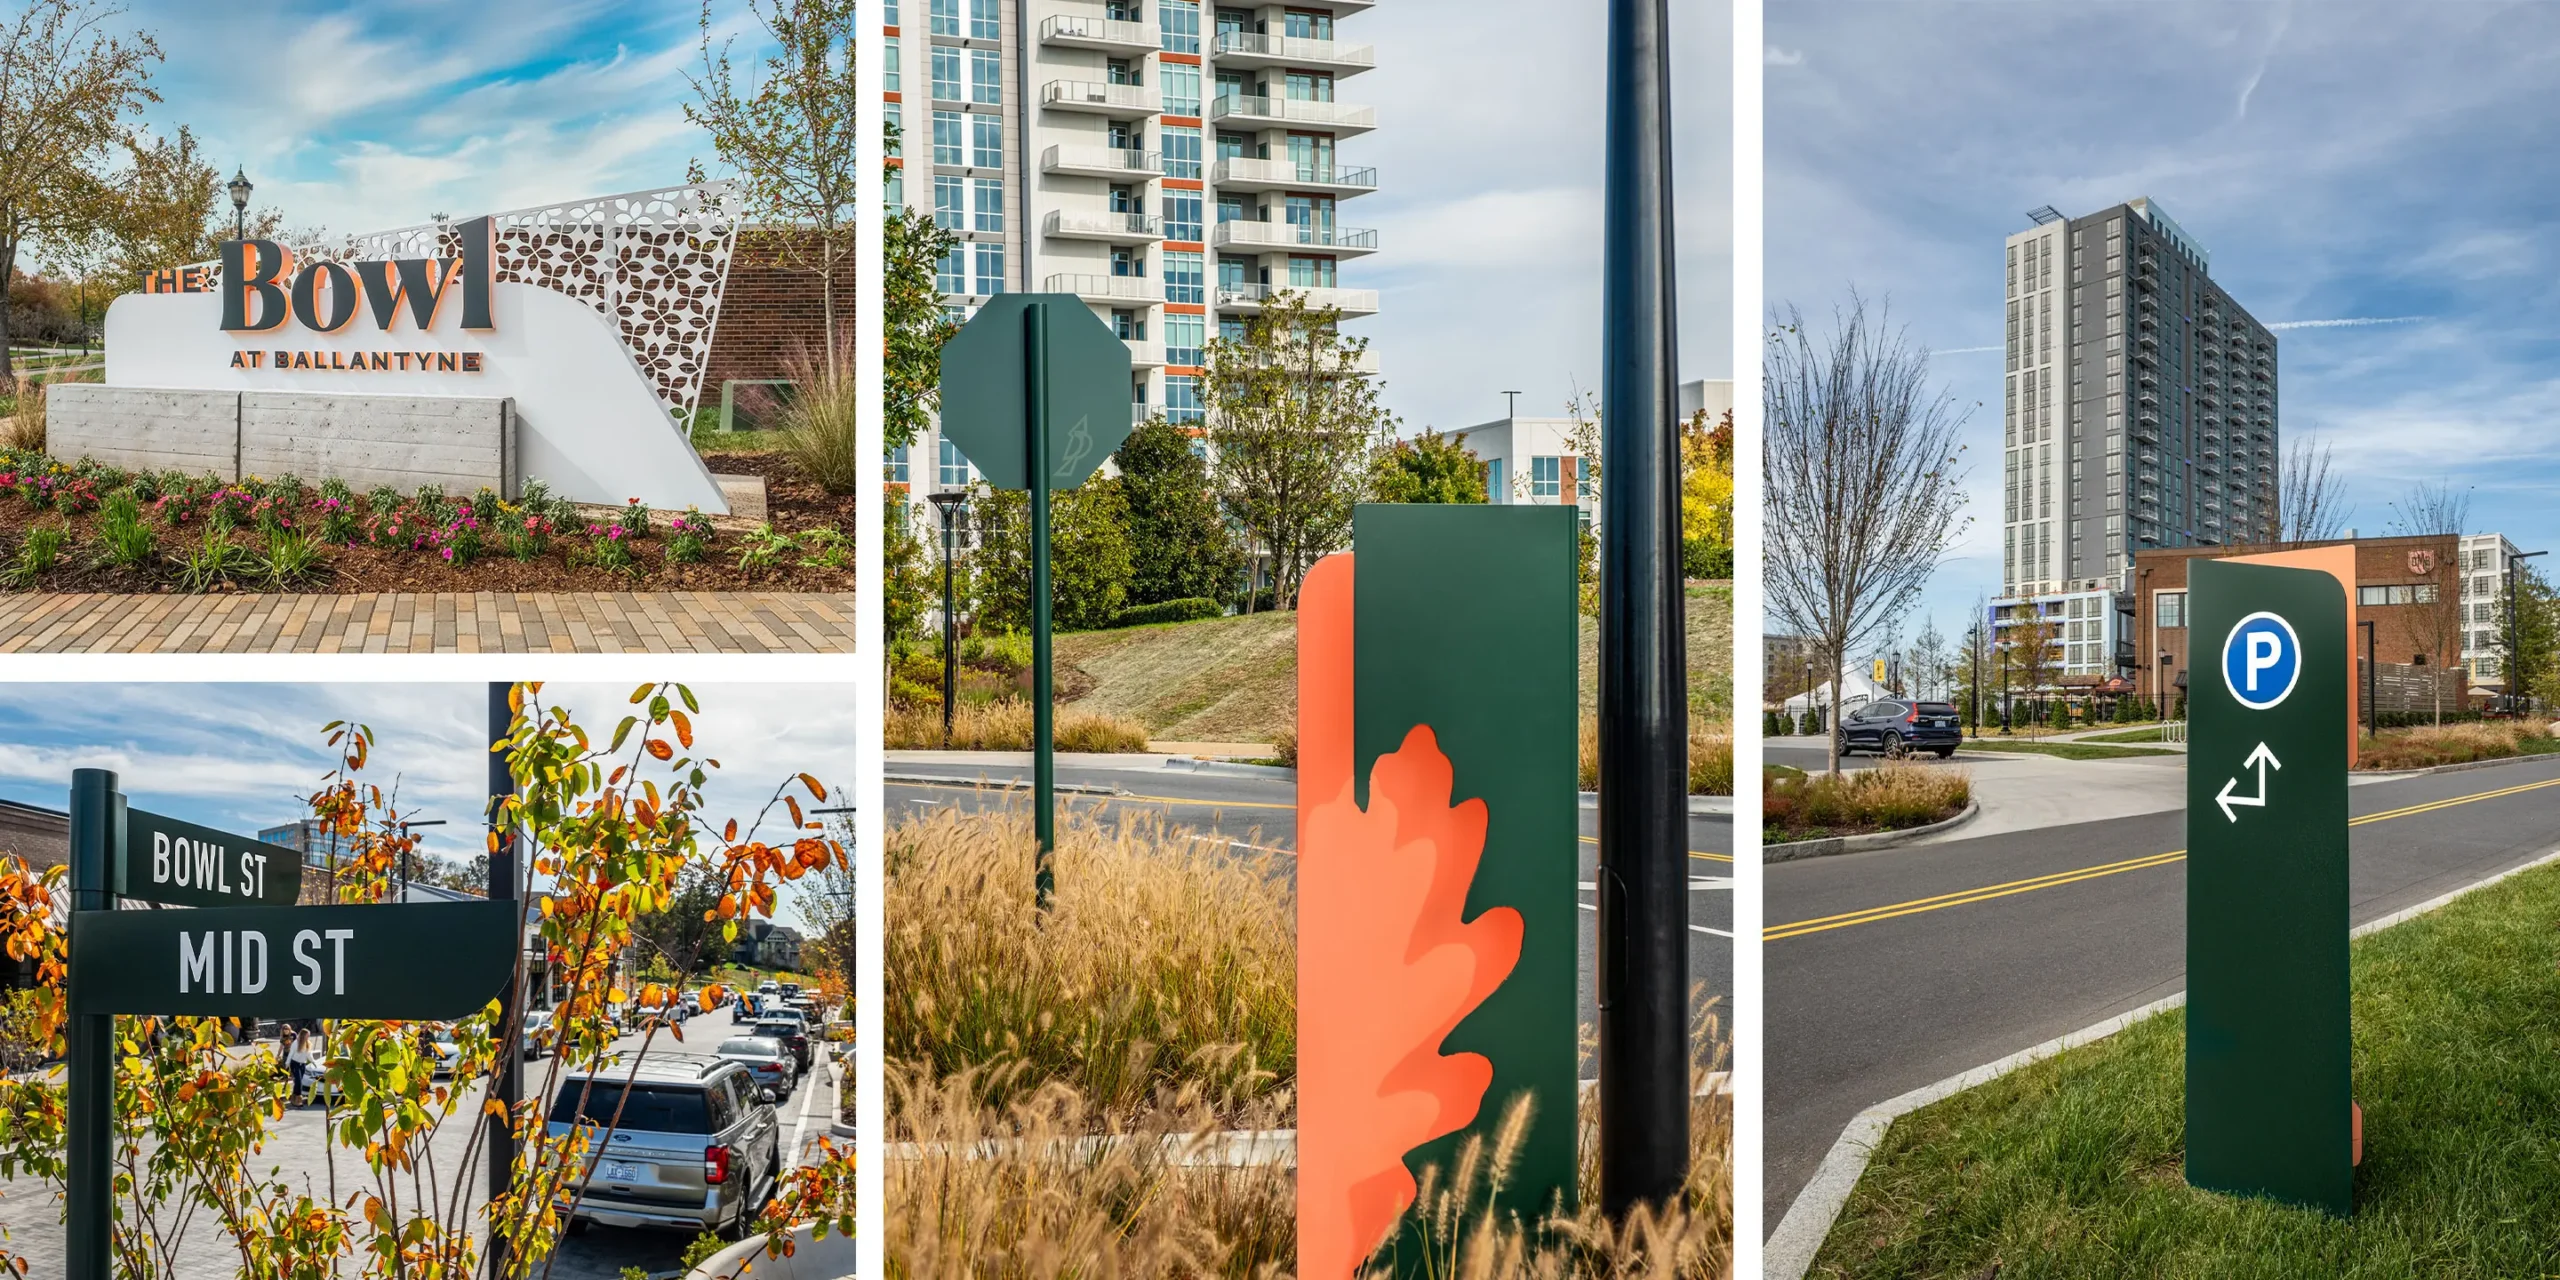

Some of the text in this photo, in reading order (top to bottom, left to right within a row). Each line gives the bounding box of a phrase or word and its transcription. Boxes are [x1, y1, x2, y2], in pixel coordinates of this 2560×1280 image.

[136, 267, 205, 294] THE
[219, 215, 495, 332] Bowl
[230, 350, 484, 373] AT BALLANTYNE
[2246, 631, 2282, 691] P
[153, 831, 267, 899] BOWL ST
[179, 928, 354, 995] MID ST
